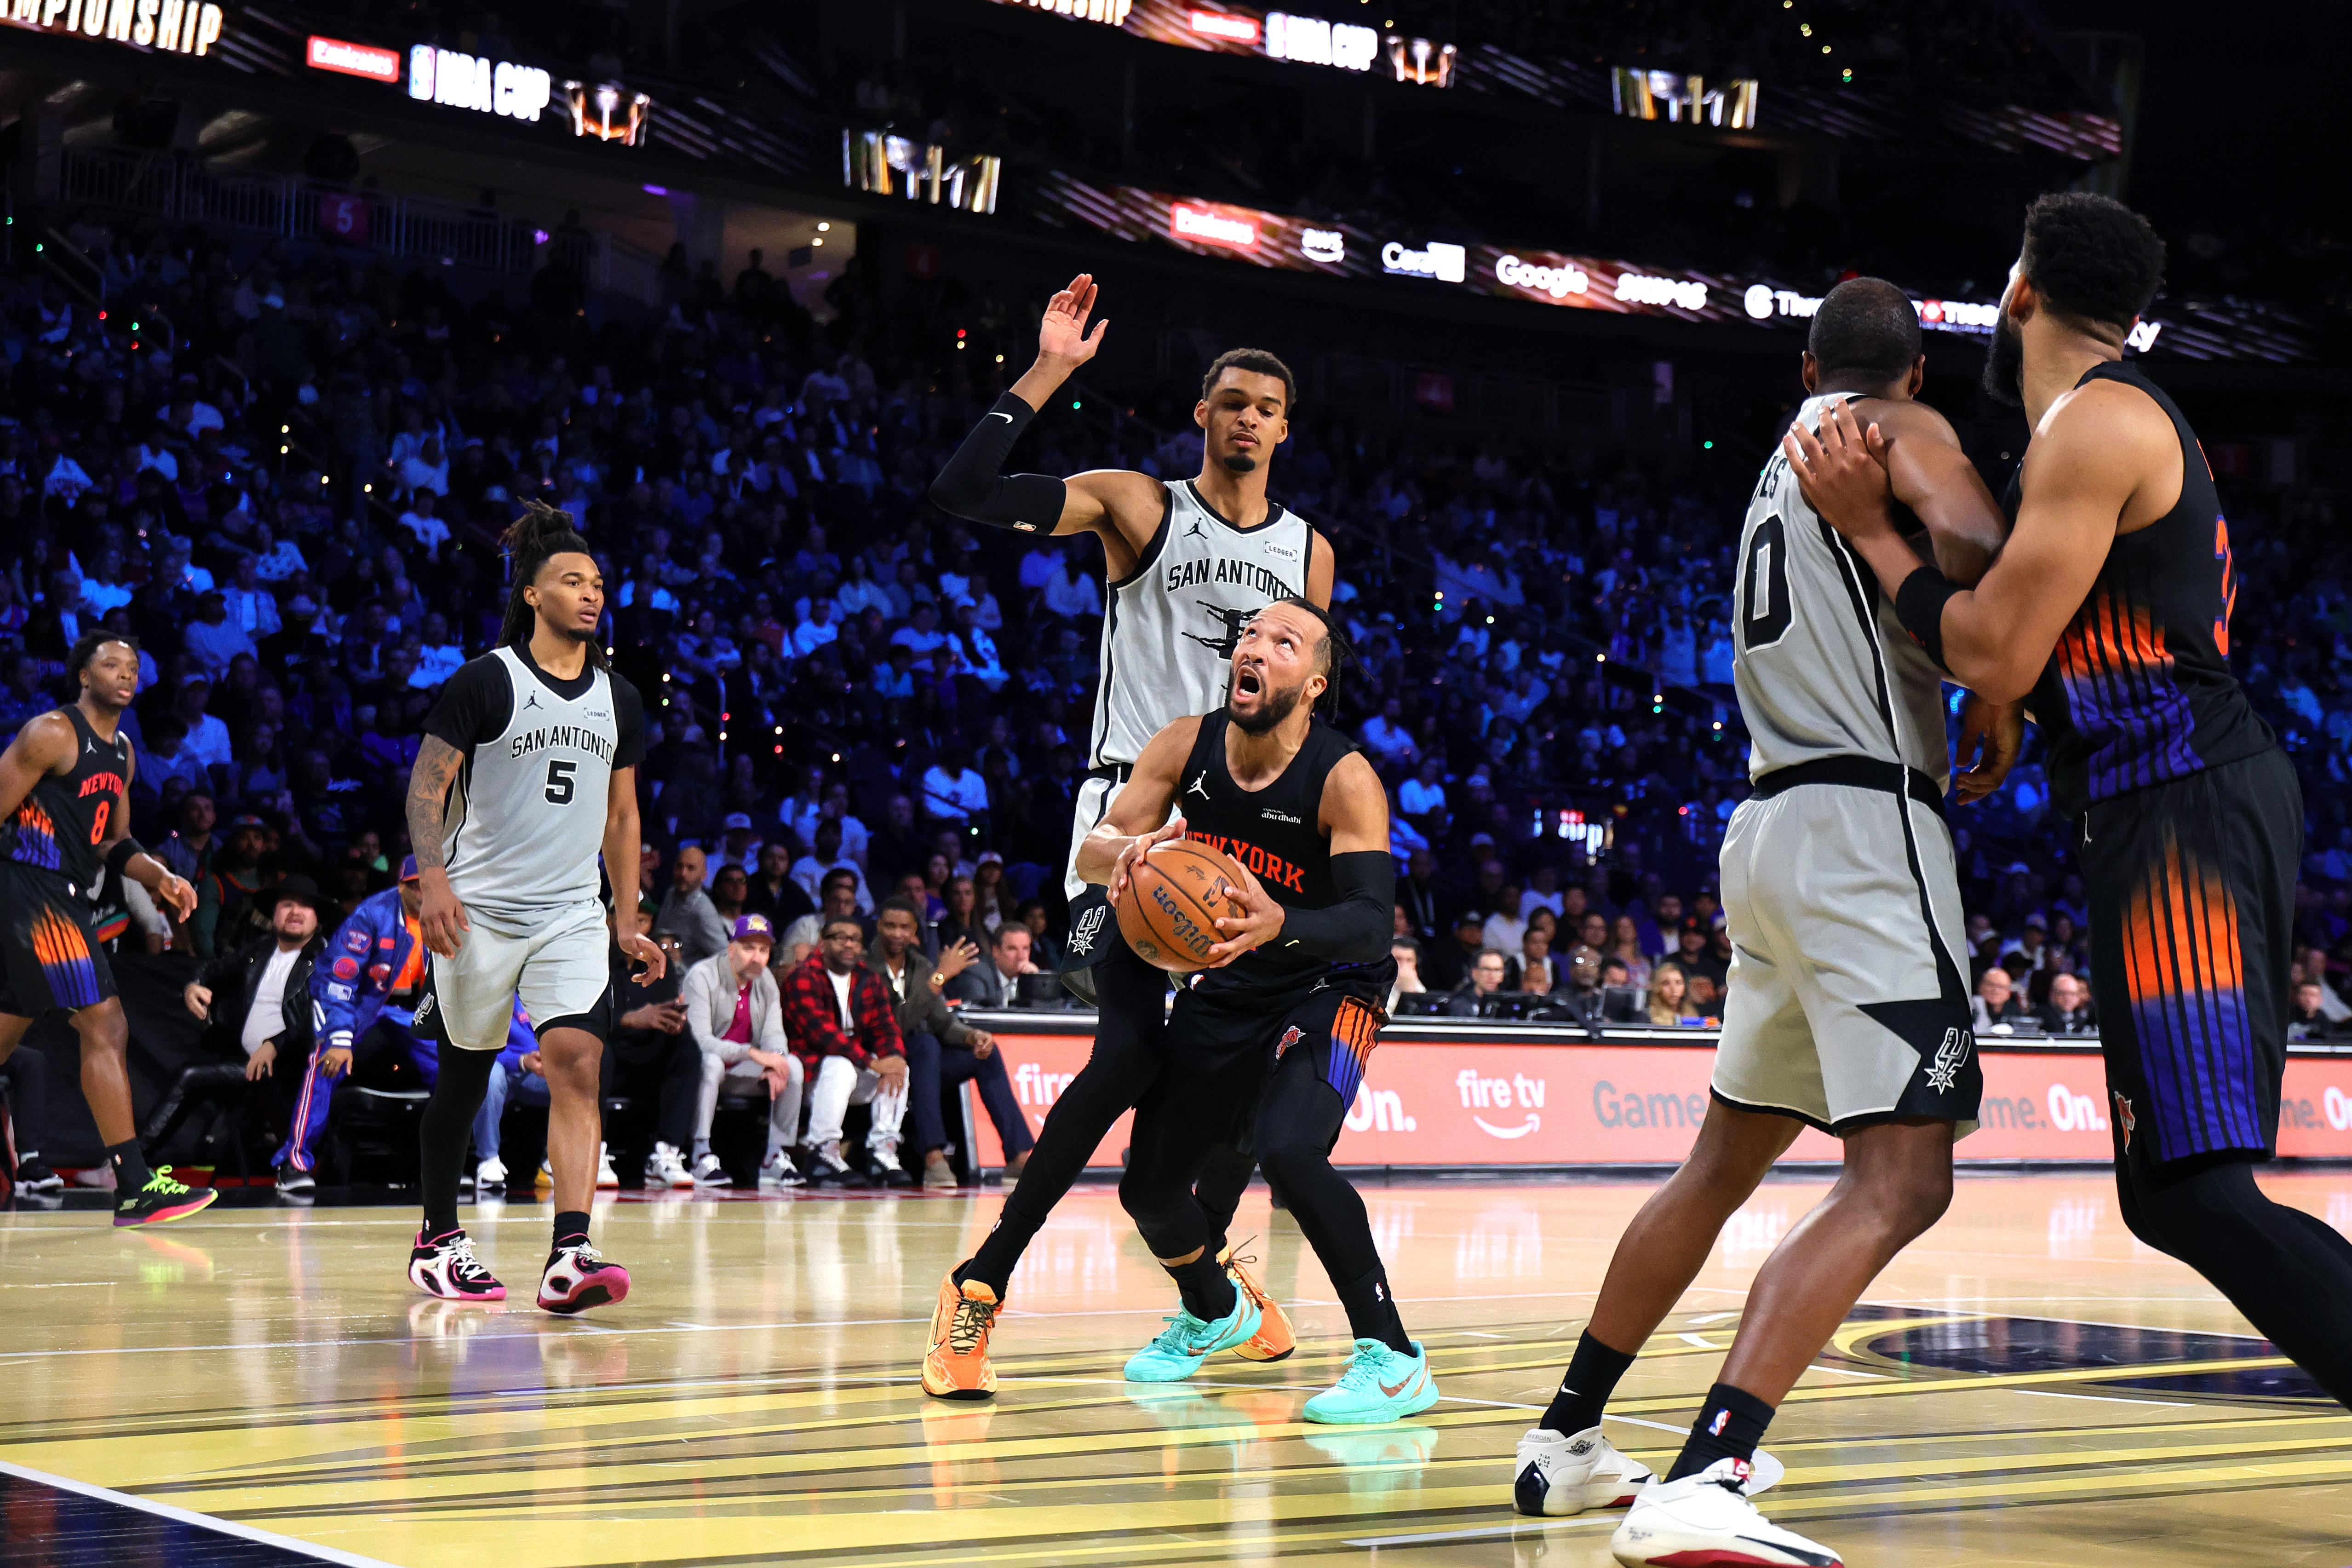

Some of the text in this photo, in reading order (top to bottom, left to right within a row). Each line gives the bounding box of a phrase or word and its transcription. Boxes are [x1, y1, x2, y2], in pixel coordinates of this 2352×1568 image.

[312, 40, 394, 76] Emirates
[336, 201, 353, 234] 5
[1496, 254, 1589, 298] Google
[1269, 545, 1293, 558] LEDGER
[1166, 557, 1211, 594] SAN
[511, 724, 614, 767] SAN ANTONIO
[78, 772, 108, 798] NEW
[543, 758, 579, 806] 5
[90, 800, 110, 845] 8
[1231, 839, 1305, 894] YORK
[1151, 883, 1216, 959] Wilson
[1342, 1080, 1417, 1132] On.
[1456, 1069, 1545, 1109] fire tv
[1593, 1080, 1707, 1128] Game
[1978, 1083, 2108, 1132] me. On.
[2323, 1086, 2352, 1131] O
